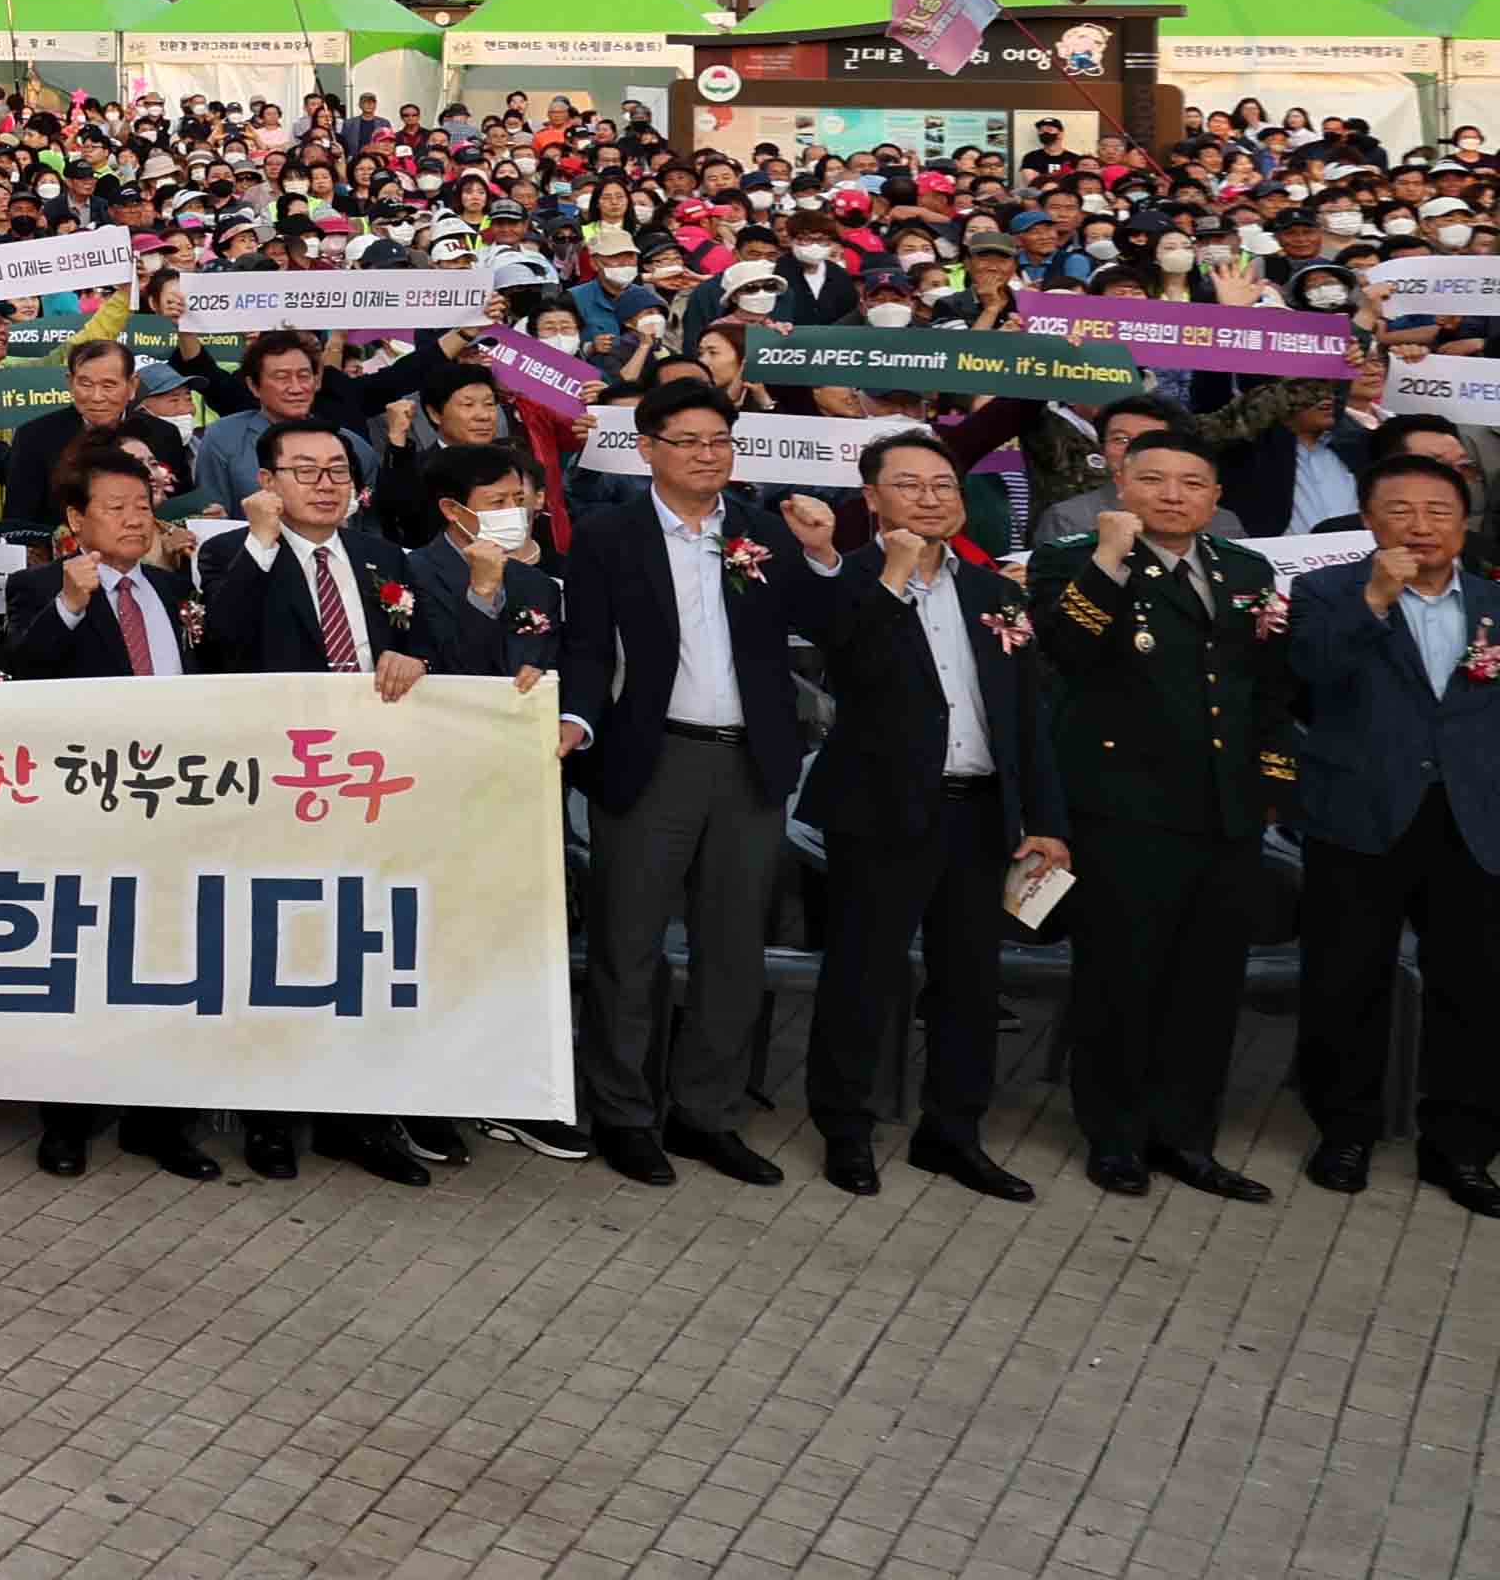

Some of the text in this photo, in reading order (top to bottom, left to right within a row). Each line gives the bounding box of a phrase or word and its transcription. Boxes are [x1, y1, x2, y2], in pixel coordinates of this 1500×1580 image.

[843, 46, 904, 72] 근대로
[1001, 47, 1053, 72] 여행
[6, 259, 54, 279] 이제는
[1431, 277, 1476, 295] APEC
[188, 289, 400, 312] 2025 APEC 정상회의 이제는
[7, 329, 40, 344] 2025
[1027, 315, 1264, 351] 2025 APEC 정상회의 인천 유치를
[757, 347, 1133, 385] 2025 APEC Summit it's Incheon
[1, 388, 25, 410] it's
[1398, 378, 1454, 399] 2025
[779, 439, 835, 462] 이제는
[53, 739, 261, 821] 행복도시
[272, 727, 417, 825] 동구
